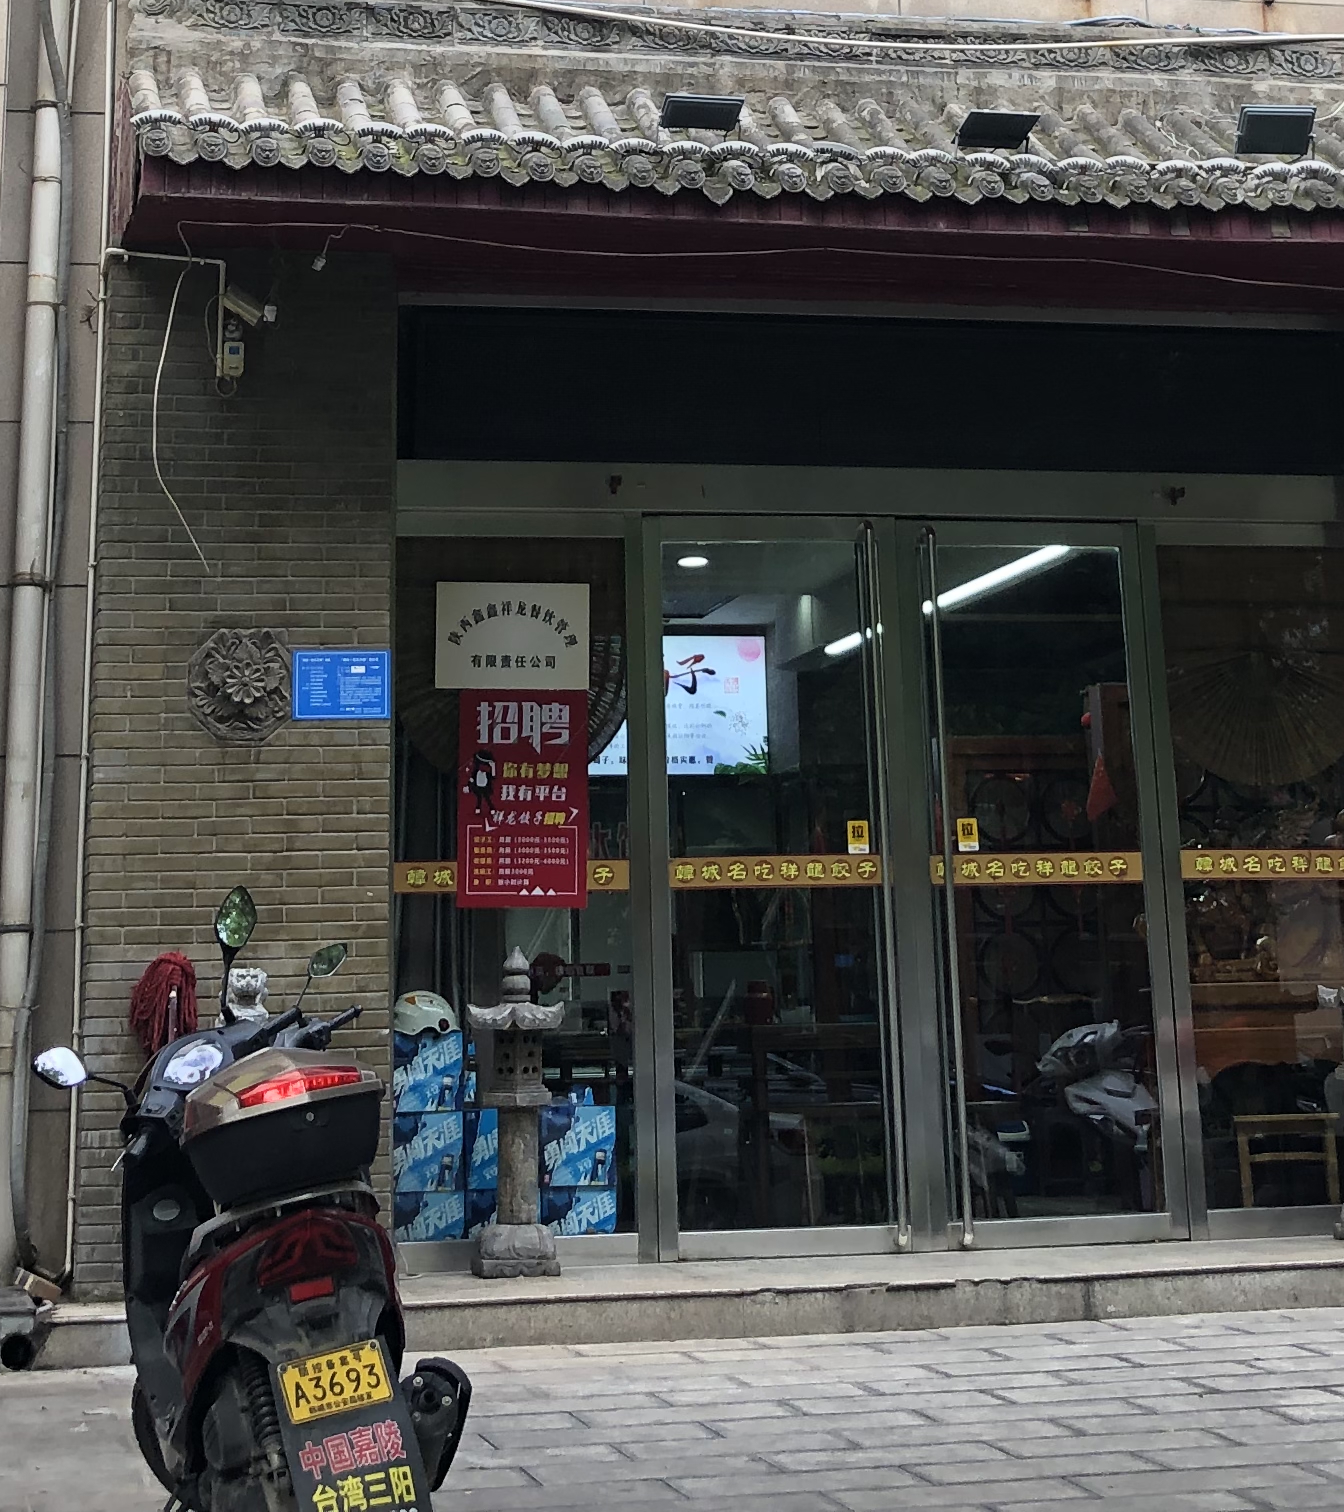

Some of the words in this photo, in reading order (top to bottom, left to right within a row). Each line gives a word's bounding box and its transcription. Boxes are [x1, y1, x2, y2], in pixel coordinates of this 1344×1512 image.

[476, 701, 570, 755] 招聘
[500, 784, 567, 801] 我有平台
[543, 1109, 616, 1172] 勇闯天涯
[294, 1362, 381, 1409] A3693
[298, 1419, 407, 1480] 中国嘉陵
[311, 1465, 417, 1512] 台湾三阳
